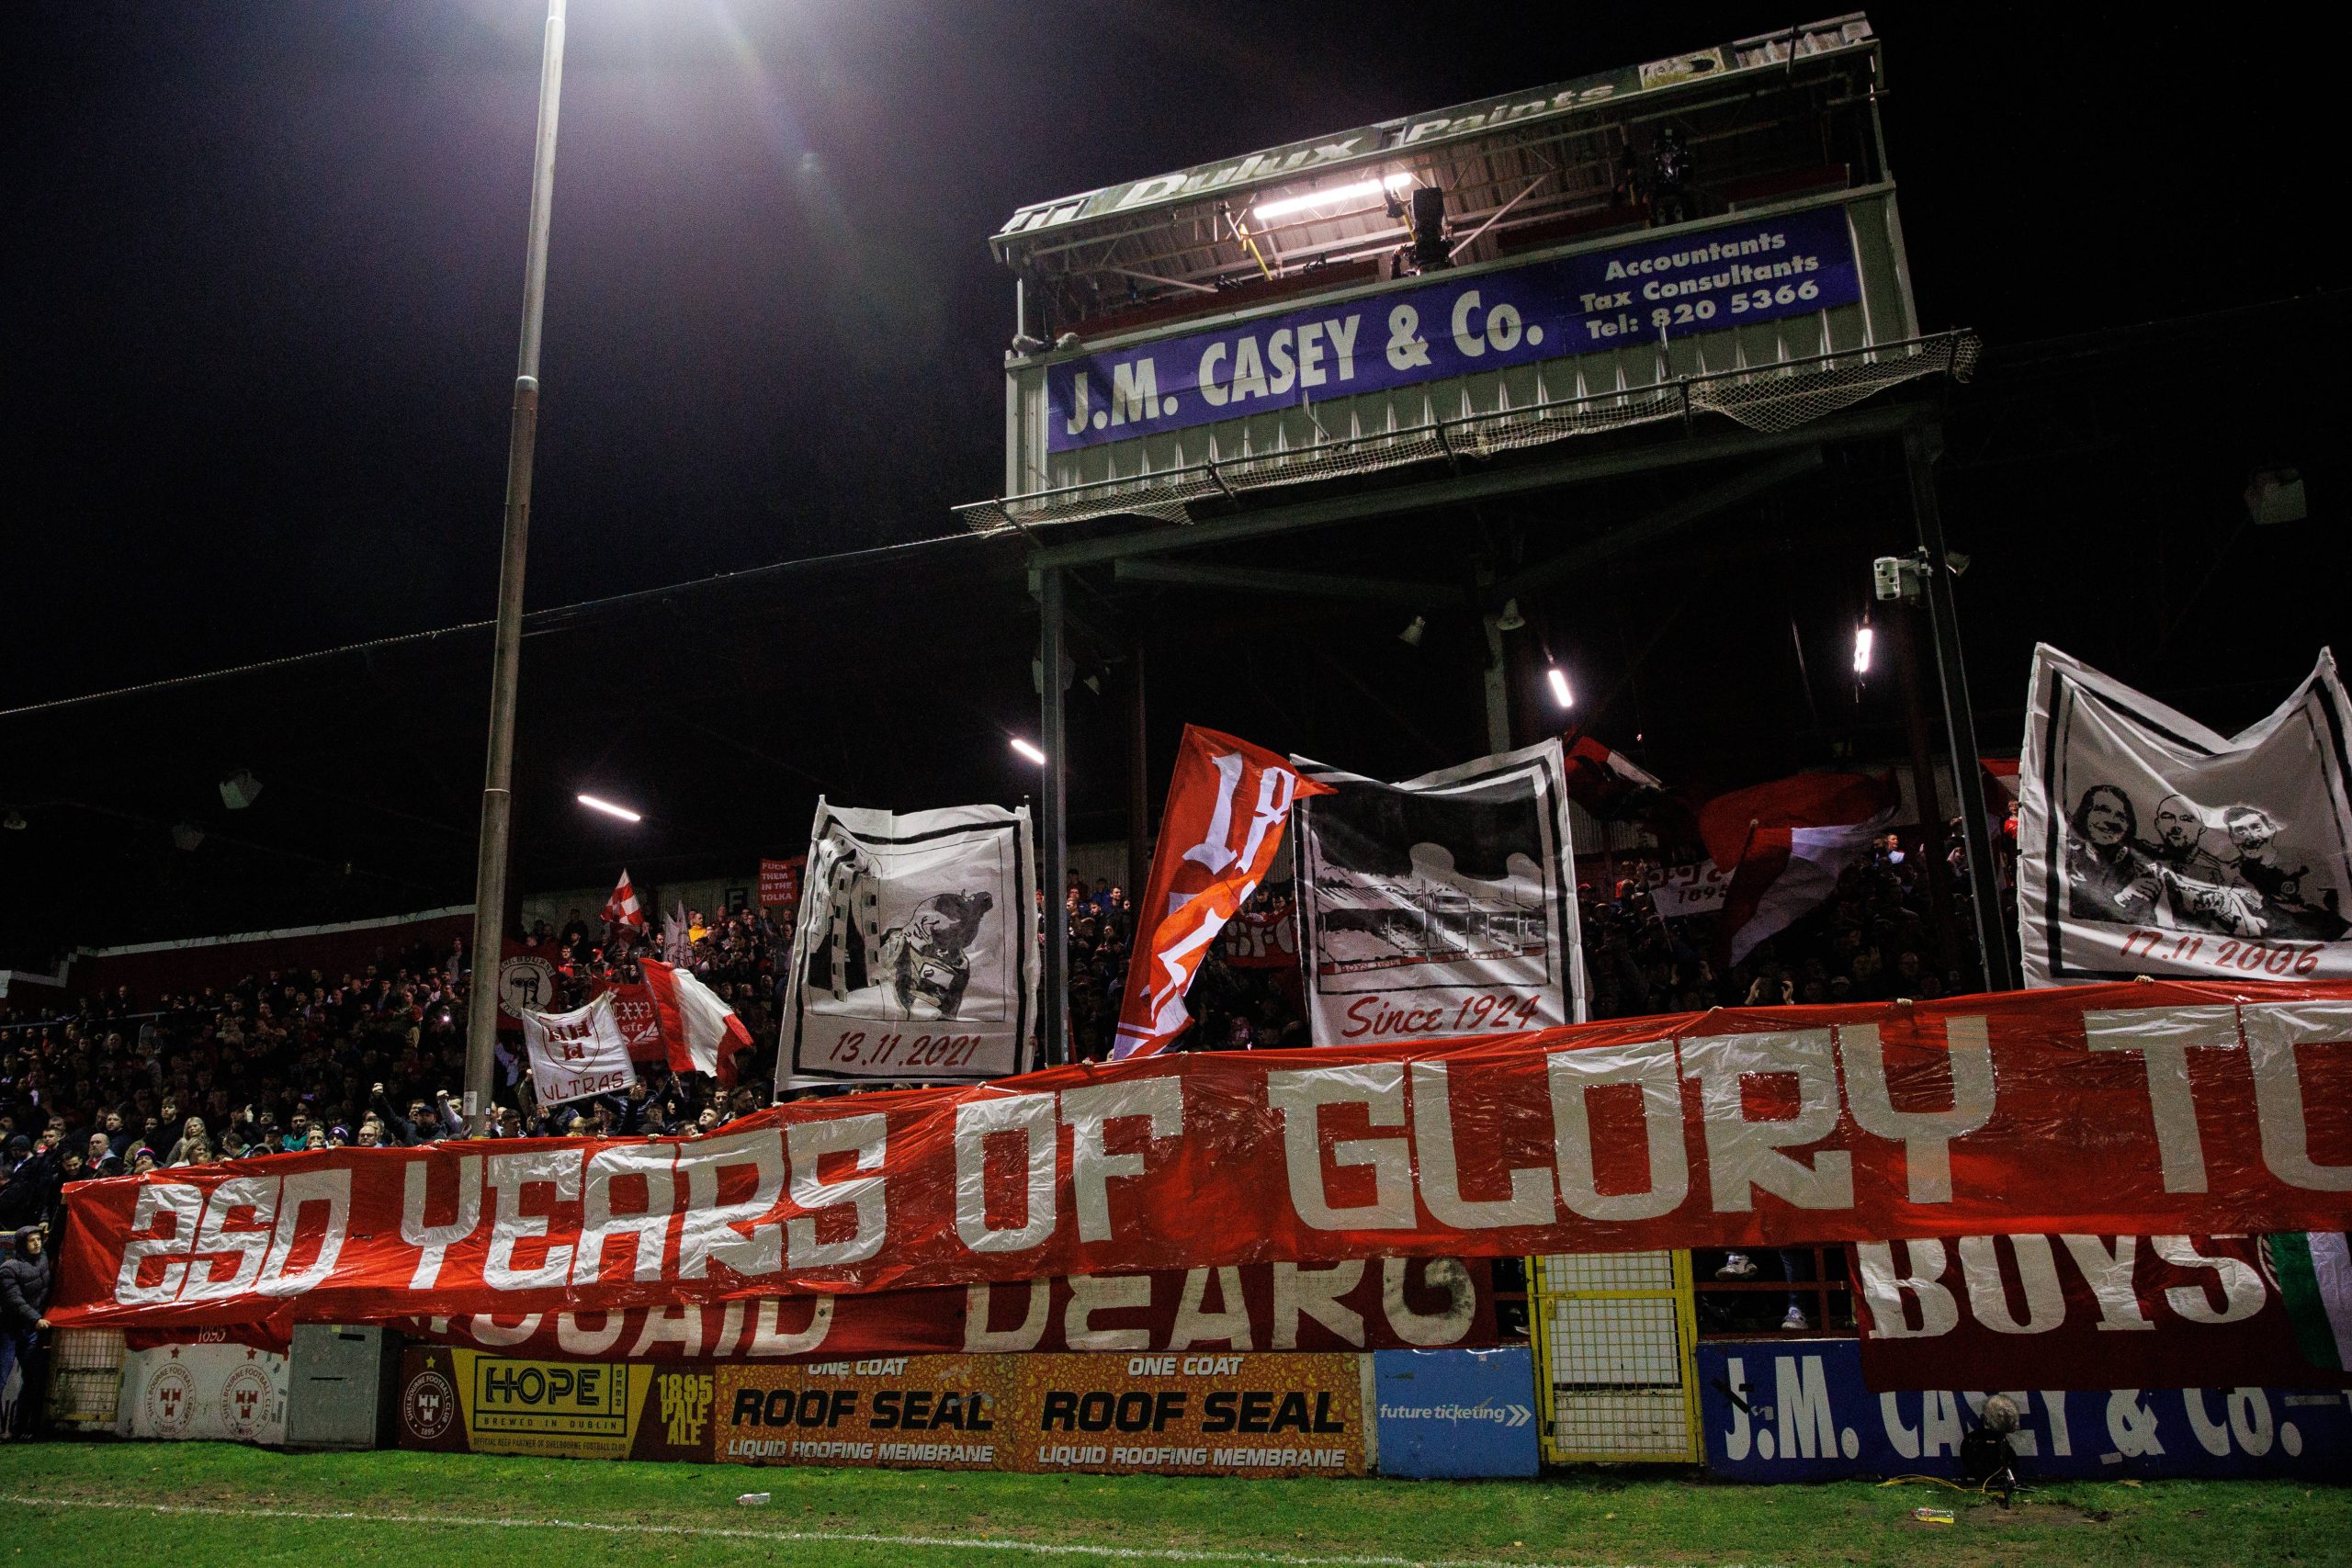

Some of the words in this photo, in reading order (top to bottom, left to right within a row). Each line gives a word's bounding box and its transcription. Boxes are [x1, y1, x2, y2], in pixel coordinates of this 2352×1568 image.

[1116, 138, 1362, 208] Dulux
[1405, 83, 1616, 142] Paints
[1605, 233, 1786, 281] Accountants
[1580, 290, 1632, 313] Tax
[1644, 255, 1819, 300] Consultants
[1586, 314, 1639, 340] Tel:
[1651, 299, 1716, 327] 820
[1731, 280, 1819, 314] 5366
[1066, 358, 1179, 435] J.M.
[1199, 315, 1362, 407] CASEY
[1385, 305, 1432, 371] &
[1452, 290, 1544, 357] Co.
[761, 872, 788, 881] THEM
[762, 863, 787, 871] FUCK
[761, 883, 772, 891] IN
[774, 882, 793, 890] THE
[761, 892, 793, 902] TOLKA
[1341, 996, 1443, 1038] Since
[1453, 994, 1542, 1030] 1924
[828, 1032, 981, 1066] 13.11.2021
[542, 1071, 624, 1100] ULTRAS
[116, 1168, 352, 1305] 250
[400, 1112, 888, 1292] YEARS
[955, 1075, 1182, 1253] OF
[1268, 1016, 1998, 1231] GLORY
[1856, 1233, 2267, 1338] BOYS
[808, 1359, 850, 1375] ONE
[855, 1359, 908, 1376] COAT
[1128, 1357, 1175, 1375] ONE
[1182, 1357, 1244, 1376] COAT
[406, 1376, 426, 1422] SHELBOURNE
[426, 1375, 451, 1401] FOOTBALL
[485, 1367, 601, 1405] HOPE
[657, 1373, 714, 1404] 1895
[483, 1416, 533, 1427] BREWED
[545, 1419, 558, 1427] IN
[570, 1420, 616, 1430] DUBLIN
[662, 1399, 707, 1426] PALE
[731, 1389, 858, 1427] ROOF
[869, 1390, 994, 1431] SEAL
[1040, 1391, 1188, 1432] ROOF
[1201, 1391, 1344, 1433] SEAL
[1380, 1404, 1431, 1419] future
[1434, 1404, 1505, 1423] ticketing
[1724, 1355, 1860, 1461] J.M.
[1880, 1390, 2072, 1459] CAEY
[2106, 1388, 2165, 1456] &
[2183, 1386, 2302, 1457] Co.
[421, 1427, 435, 1436] 1895
[473, 1437, 496, 1446] OFFICIAL
[513, 1438, 536, 1448] PARTNER
[546, 1440, 582, 1450] SHELBOURNE
[583, 1441, 611, 1450] FOOTBALL
[612, 1442, 626, 1451] CLUB
[667, 1418, 700, 1446] ALE
[728, 1439, 786, 1460] LIQUID
[792, 1441, 873, 1461] ROOFING
[878, 1444, 994, 1462] MEMBRANE
[1038, 1446, 1106, 1465] LIQUID
[1112, 1446, 1207, 1466] ROOFING
[1213, 1448, 1346, 1467] MEMBRANE
